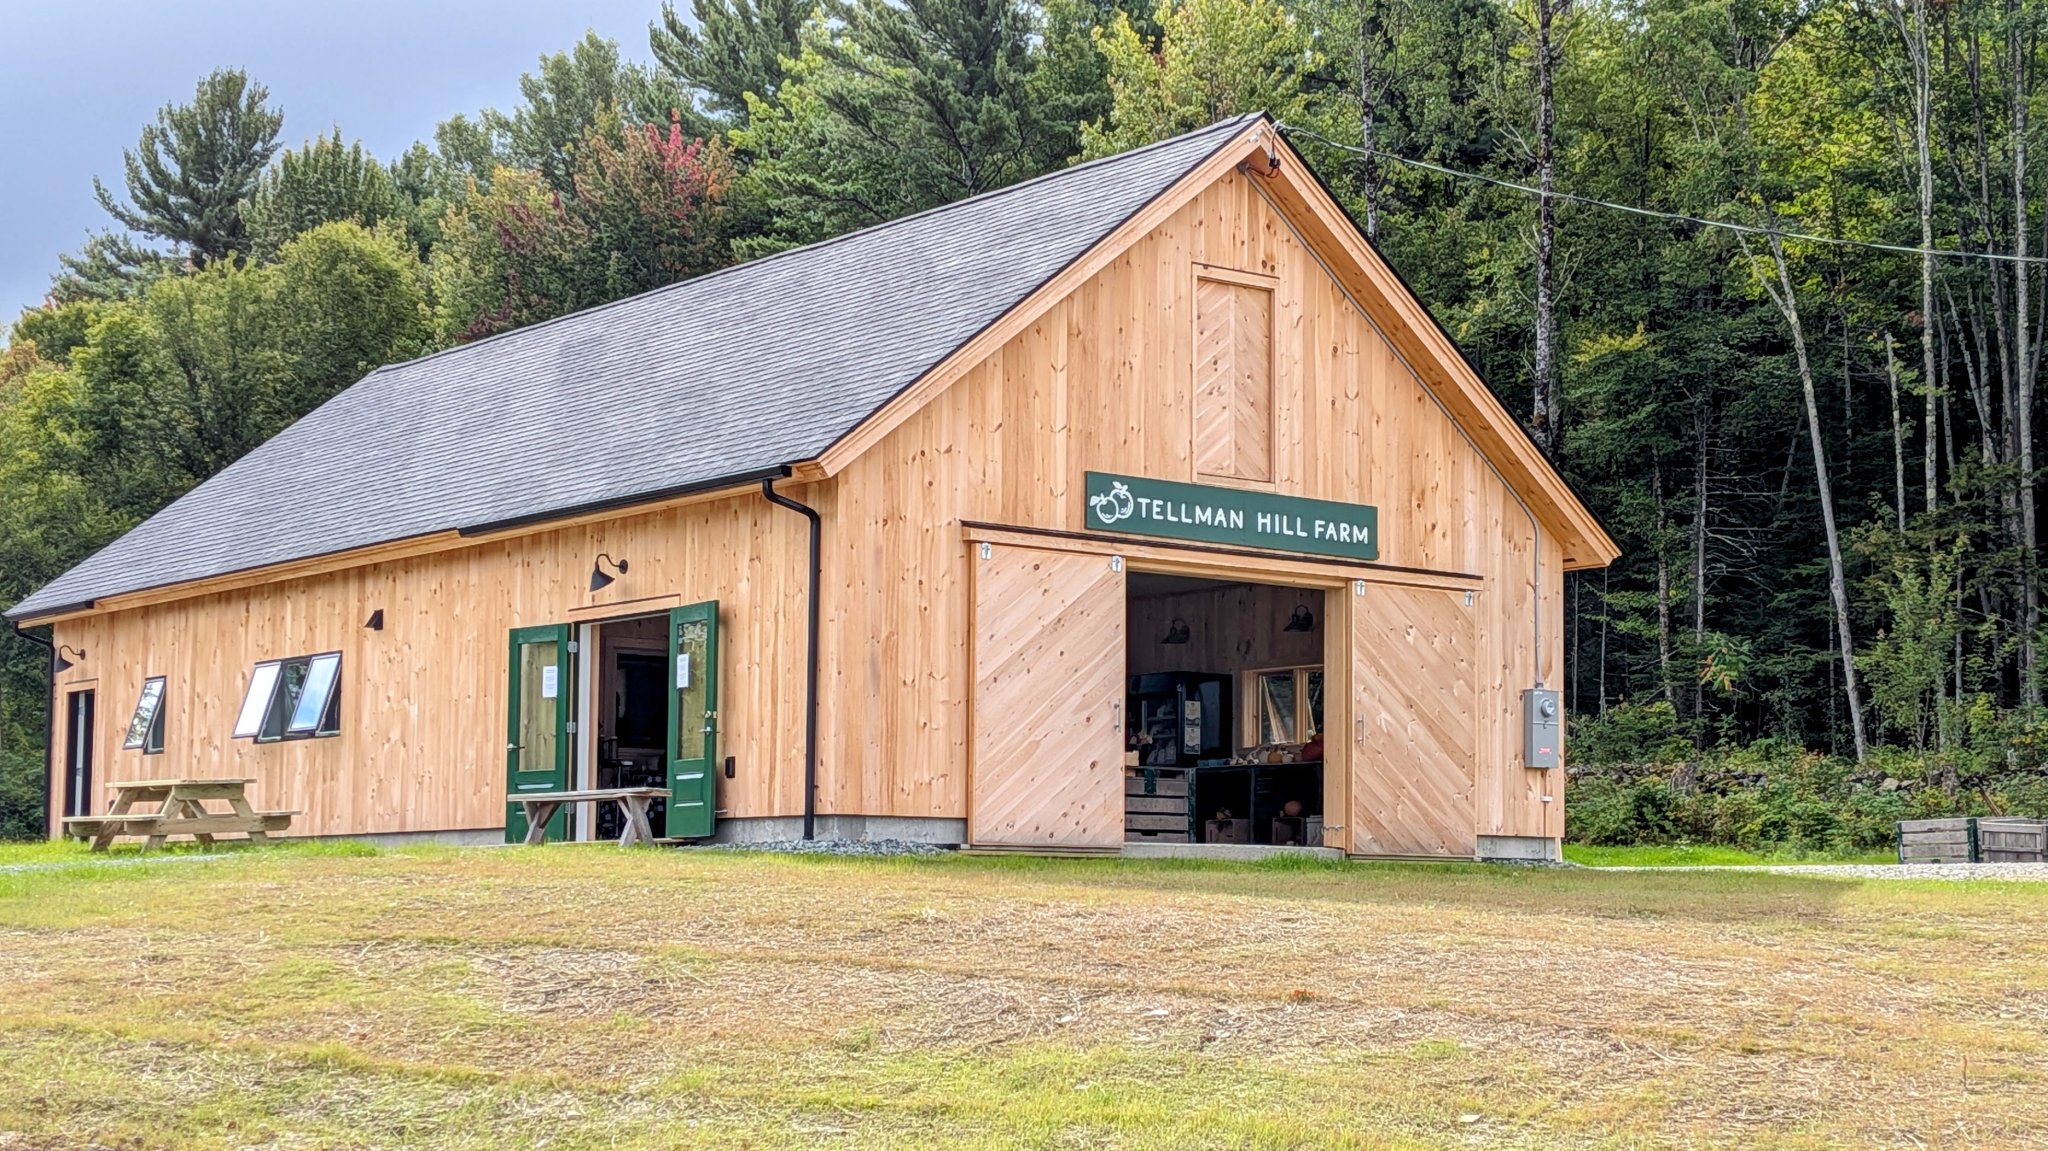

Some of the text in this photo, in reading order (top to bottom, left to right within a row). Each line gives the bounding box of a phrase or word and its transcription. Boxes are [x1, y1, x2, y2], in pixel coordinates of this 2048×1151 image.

[1137, 497, 1369, 545] TELLMAN HILL FARM
